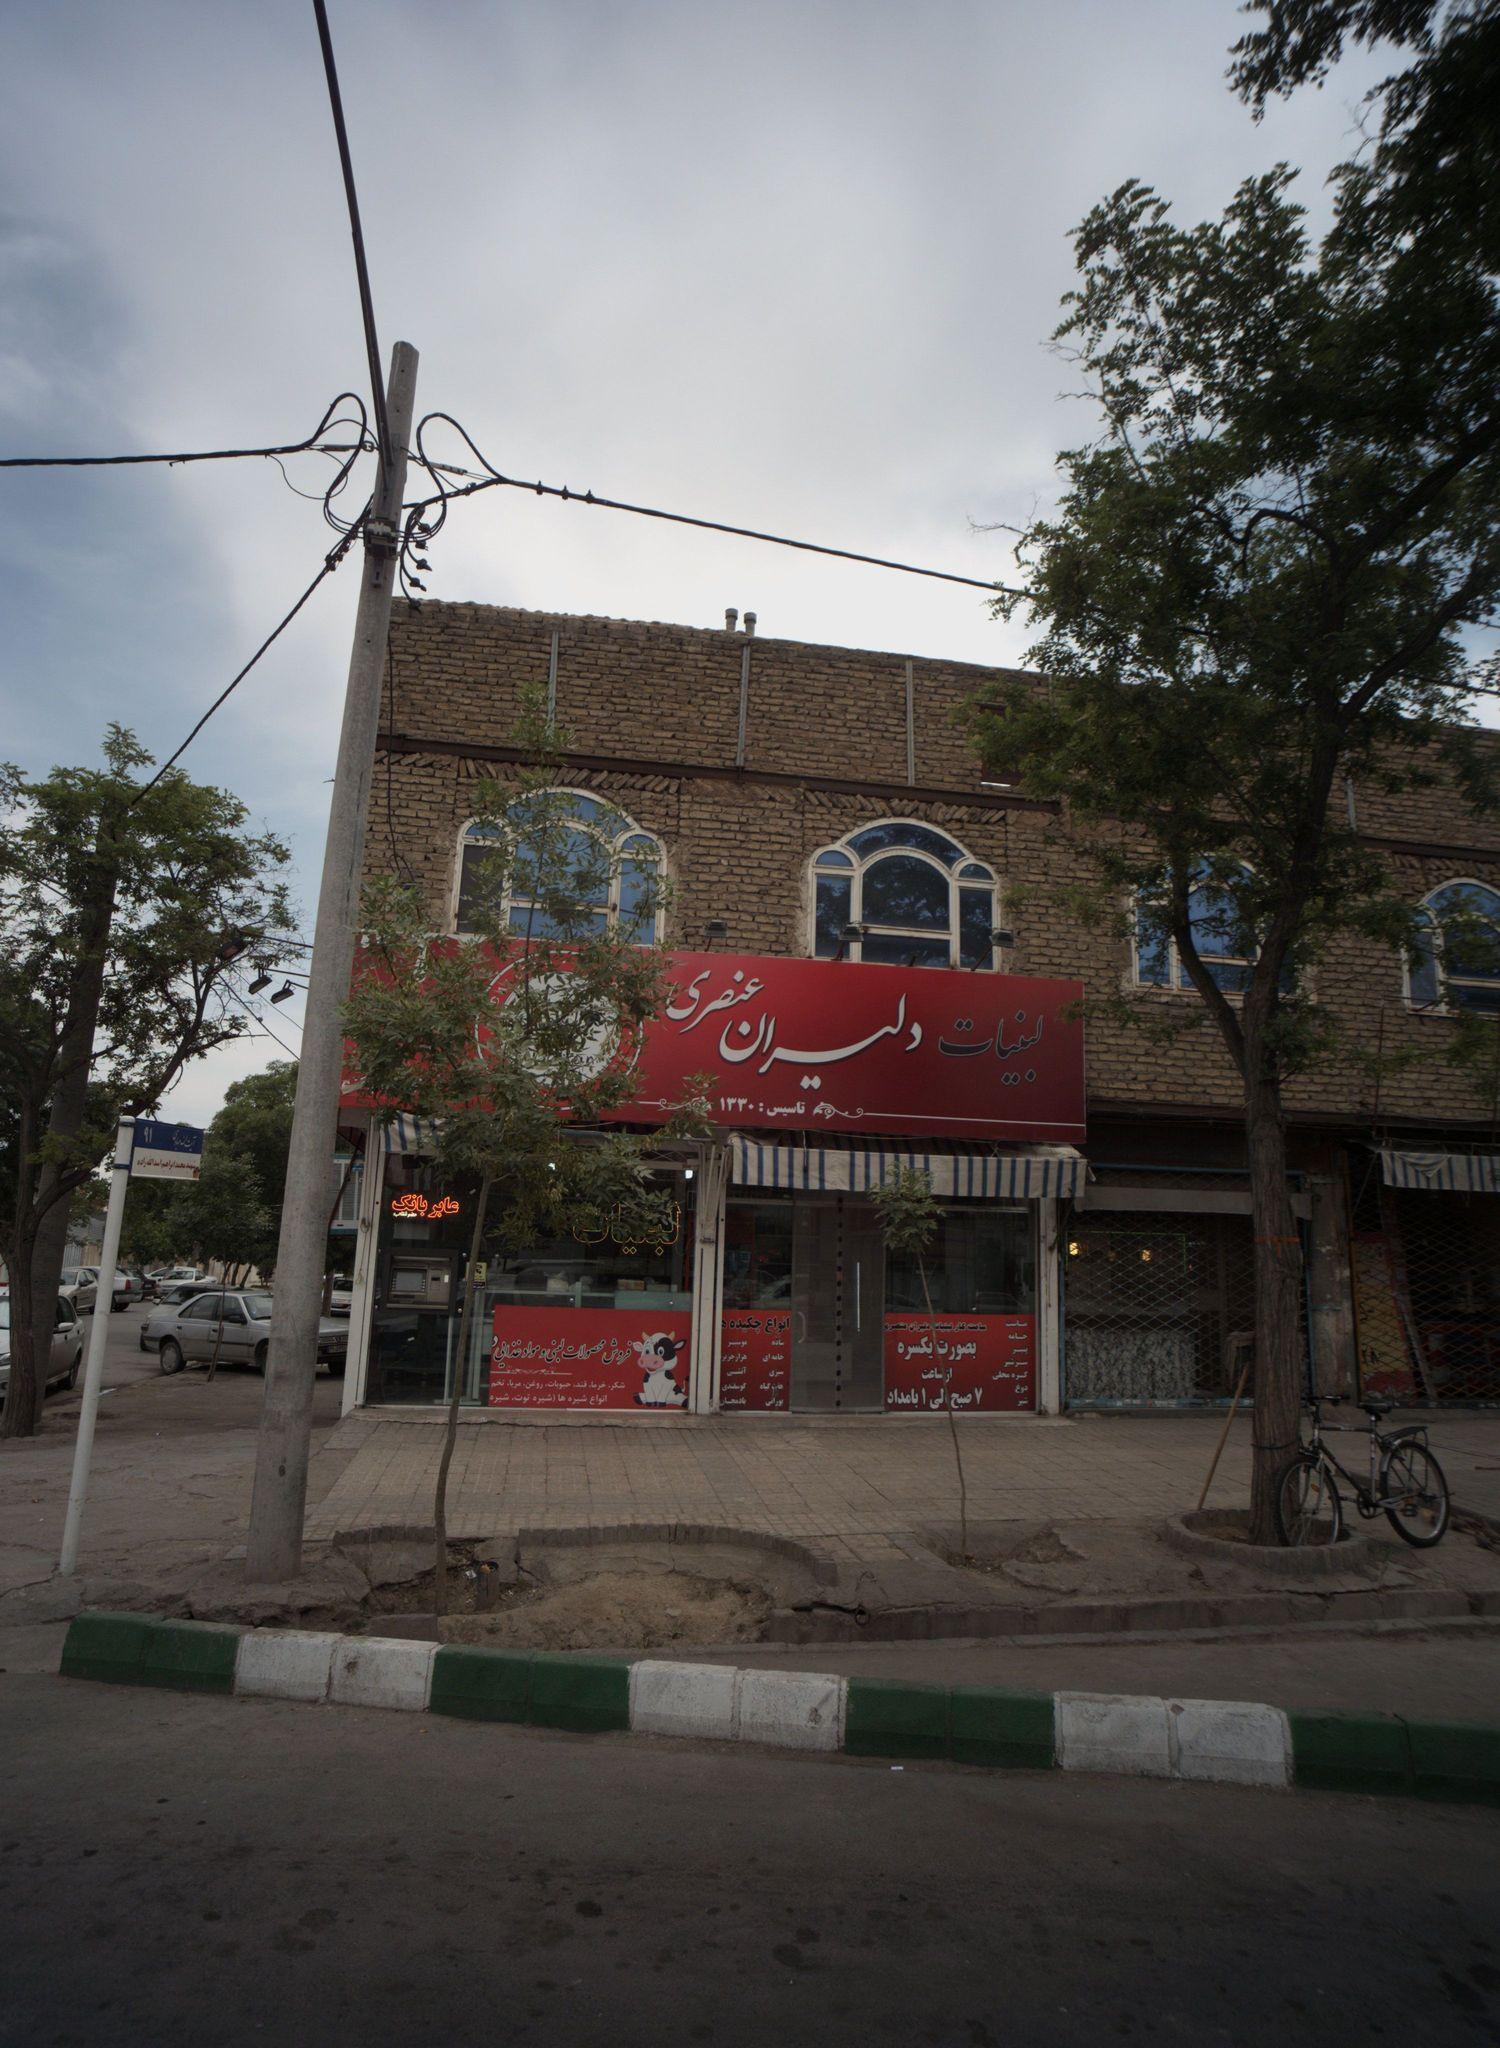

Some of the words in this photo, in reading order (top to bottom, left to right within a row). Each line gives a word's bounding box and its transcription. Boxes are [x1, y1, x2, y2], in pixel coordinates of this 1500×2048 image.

[664, 969, 765, 1034] عنصری
[719, 992, 923, 1090] دلیران
[938, 1009, 1045, 1087] لبنیات
[719, 1096, 755, 1113] ۱۳۳۰
[391, 1193, 428, 1217] بانک
[427, 1195, 460, 1219] عابر
[729, 1316, 762, 1335] چکیده
[764, 1317, 791, 1334] انواع
[562, 1339, 606, 1360] محصولات
[602, 1337, 632, 1365] فروش
[897, 1336, 933, 1360] یکسره
[936, 1337, 977, 1360] بصورت
[921, 1368, 943, 1380] ساعت
[887, 1386, 919, 1409] بامداد
[929, 1387, 947, 1409] لی
[950, 1390, 973, 1409] صبح
[974, 1386, 983, 1405] ۷
